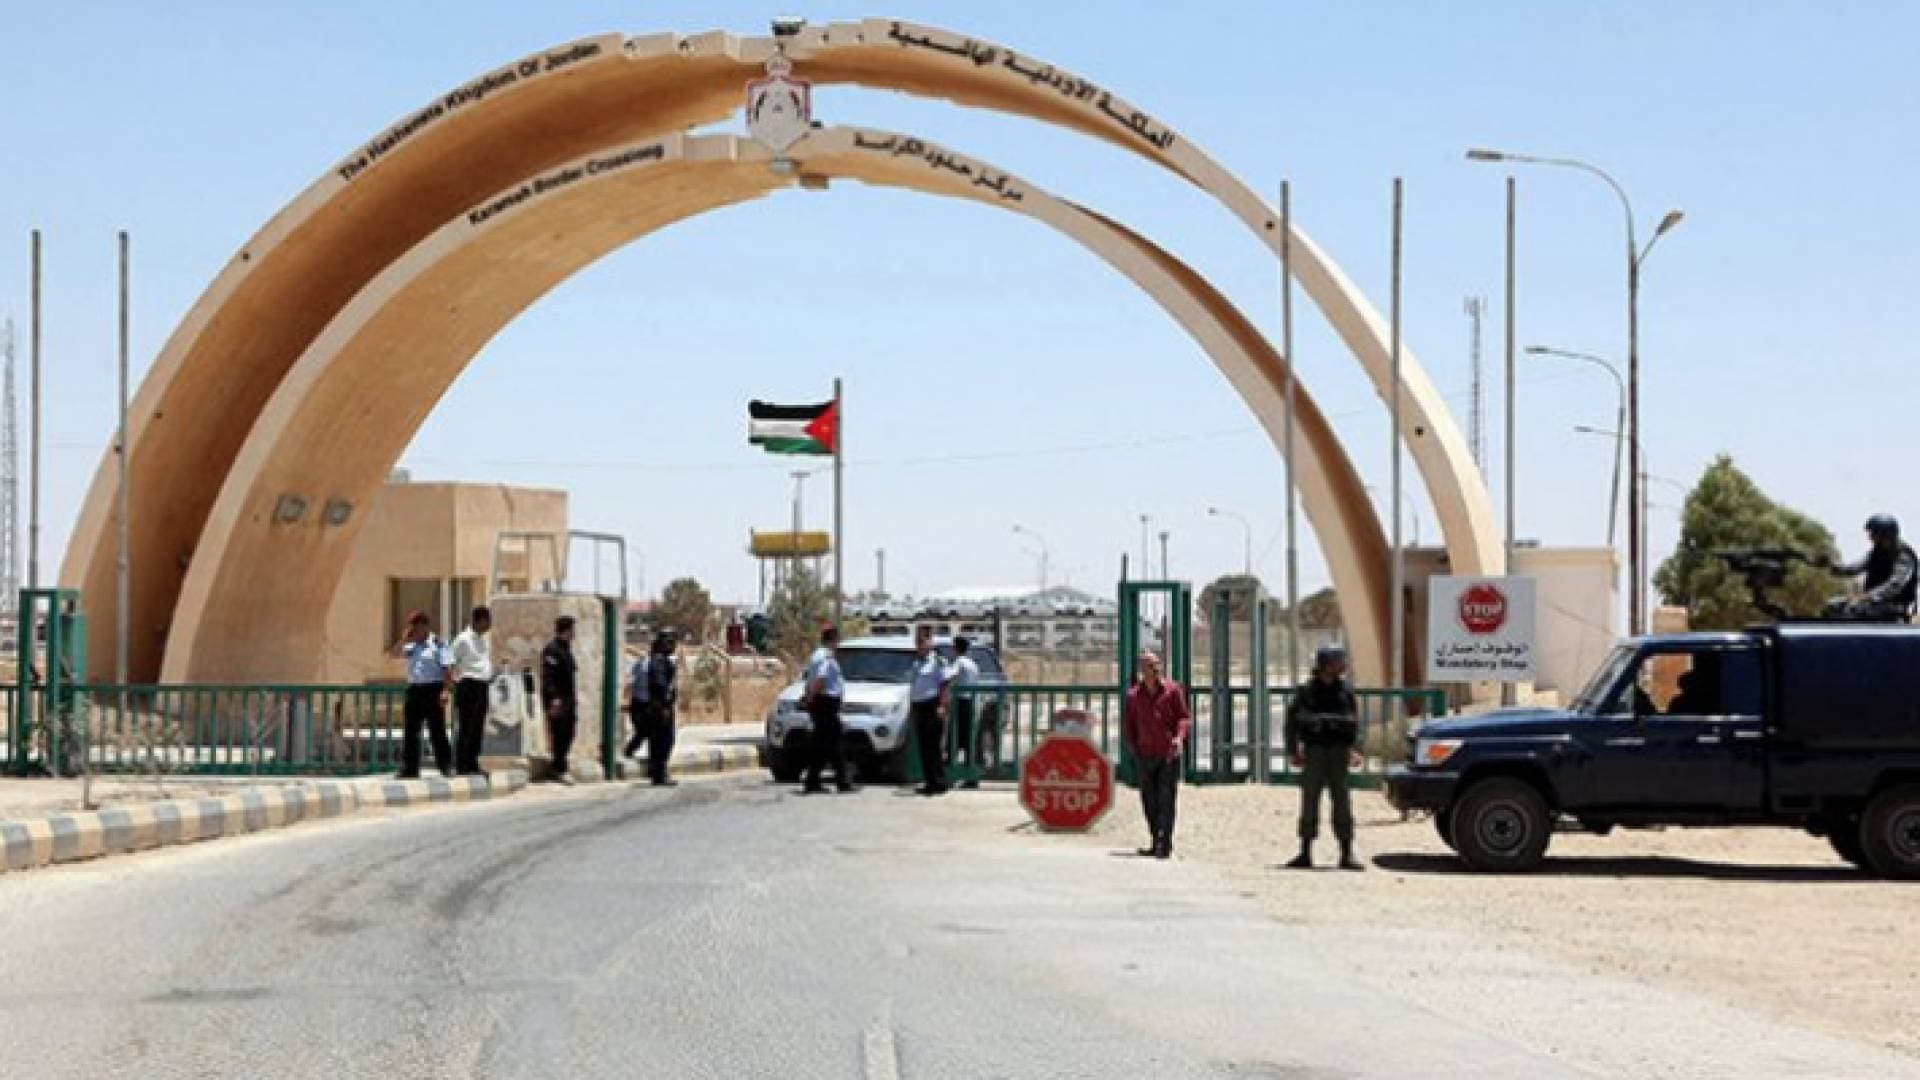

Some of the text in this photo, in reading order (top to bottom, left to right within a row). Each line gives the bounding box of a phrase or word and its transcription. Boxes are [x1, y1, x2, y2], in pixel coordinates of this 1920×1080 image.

[337, 157, 368, 182] The
[445, 71, 517, 110] Kingdom
[518, 58, 540, 78] Of
[545, 43, 601, 70] Jordan
[533, 168, 583, 193] Border
[586, 143, 664, 175] Crossing
[1463, 601, 1503, 618] STOP
[1436, 658, 1497, 671] Mandatory
[1031, 790, 1099, 812] STOP
